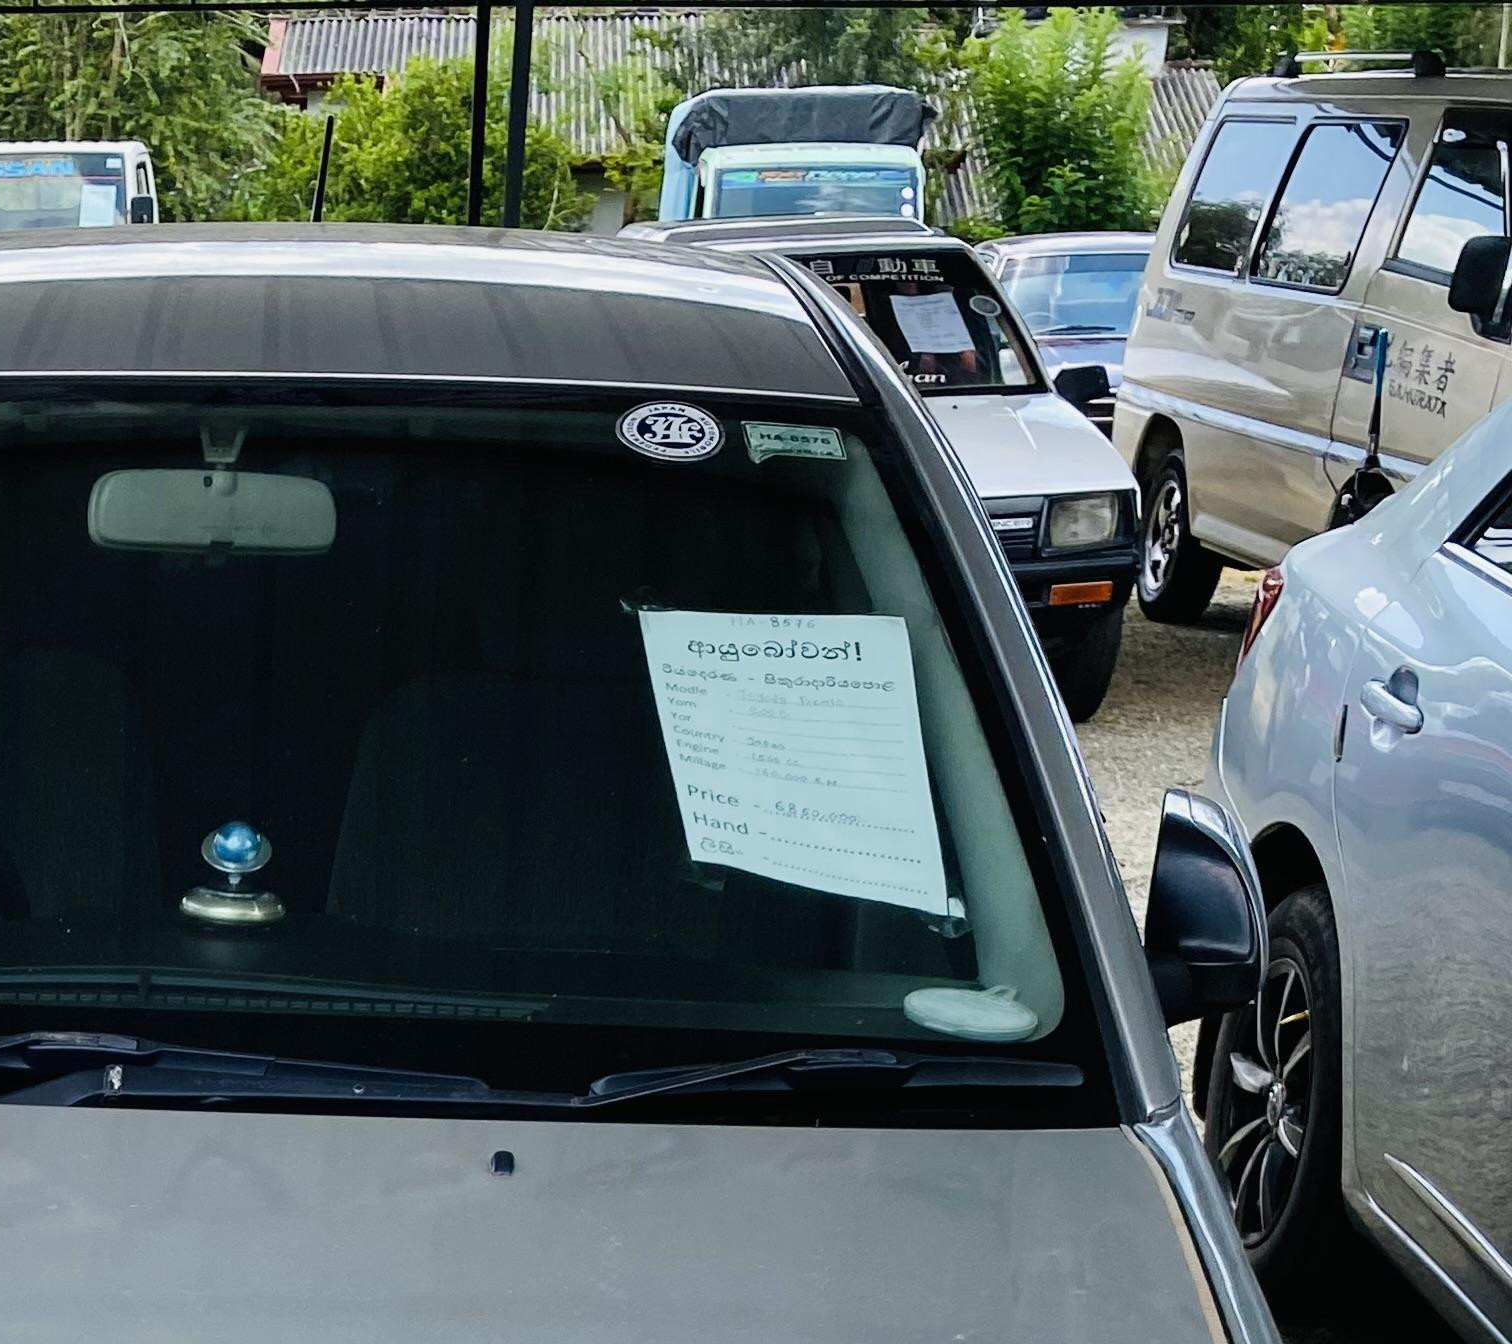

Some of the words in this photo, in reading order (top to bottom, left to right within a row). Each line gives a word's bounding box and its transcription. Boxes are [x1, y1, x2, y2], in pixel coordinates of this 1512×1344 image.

[825, 274, 843, 282] OF
[849, 274, 945, 282] COMPETITION
[648, 406, 687, 414] JAPAN
[687, 639, 863, 662] ආයුබෝවන්!
[672, 725, 725, 744] Country
[676, 739, 720, 756] Engine
[687, 784, 740, 808] Price
[692, 811, 750, 835] Hand
